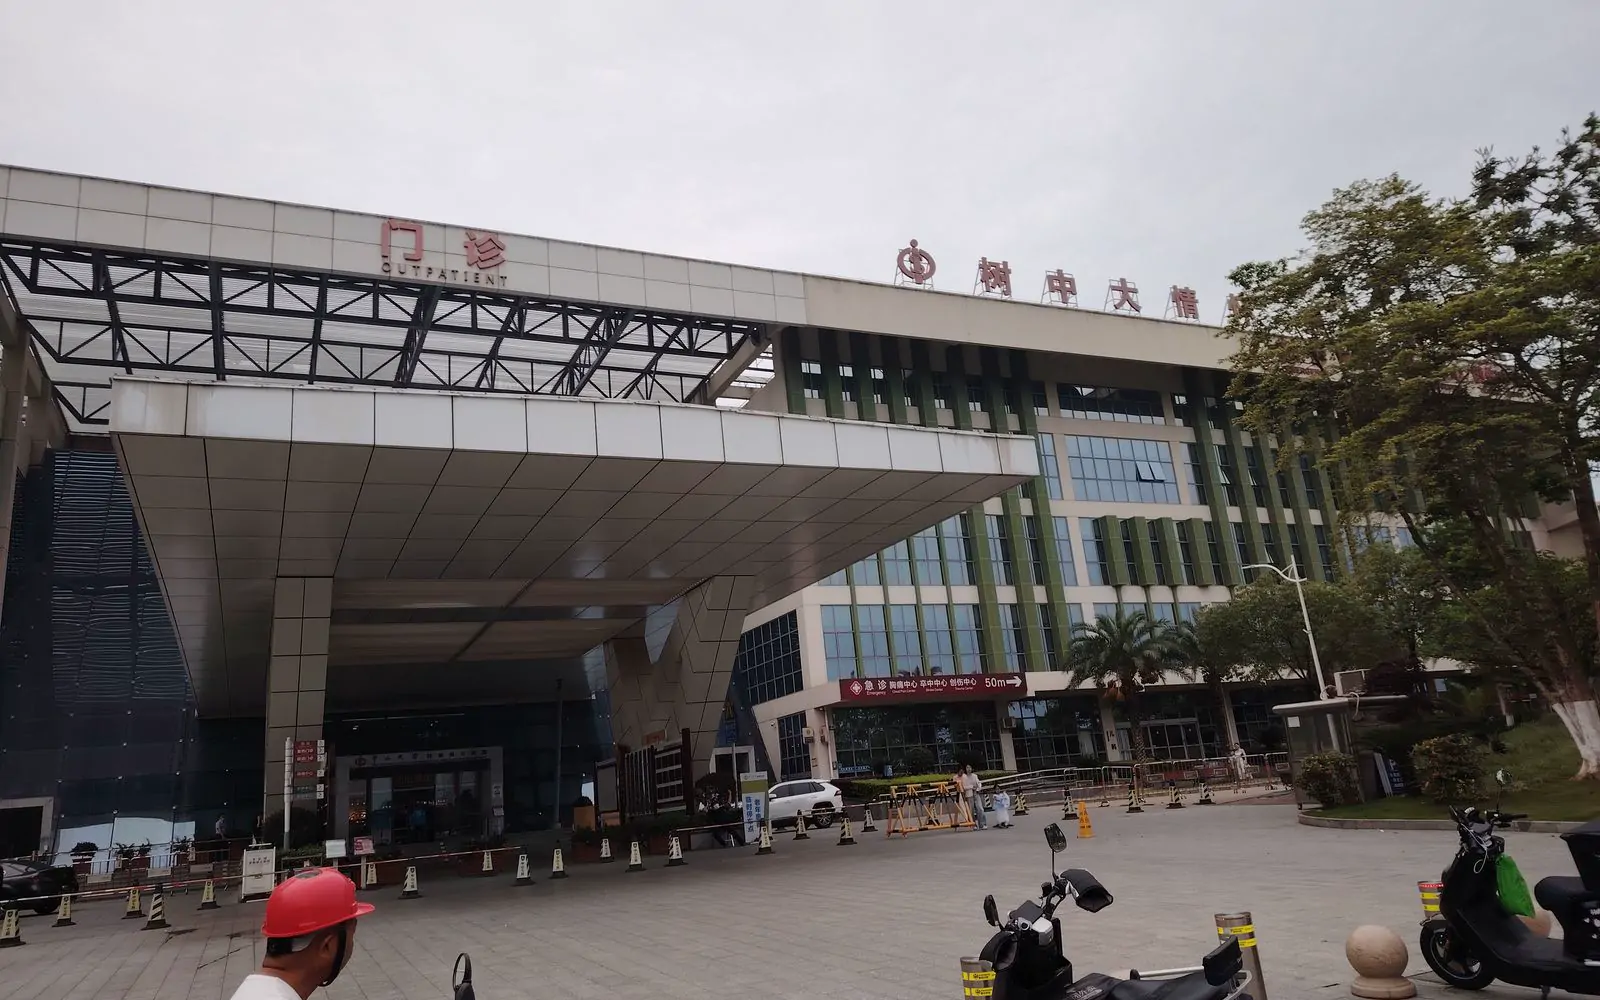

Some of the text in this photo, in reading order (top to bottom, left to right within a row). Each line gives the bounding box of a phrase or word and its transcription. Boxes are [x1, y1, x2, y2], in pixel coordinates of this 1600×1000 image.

[381, 218, 506, 270] 门诊
[382, 262, 507, 287] OUTPATIENT
[864, 679, 887, 691] 急诊
[919, 678, 948, 688] 卒中中心
[949, 677, 977, 687] 创伤中心
[985, 677, 1006, 688] 50m
